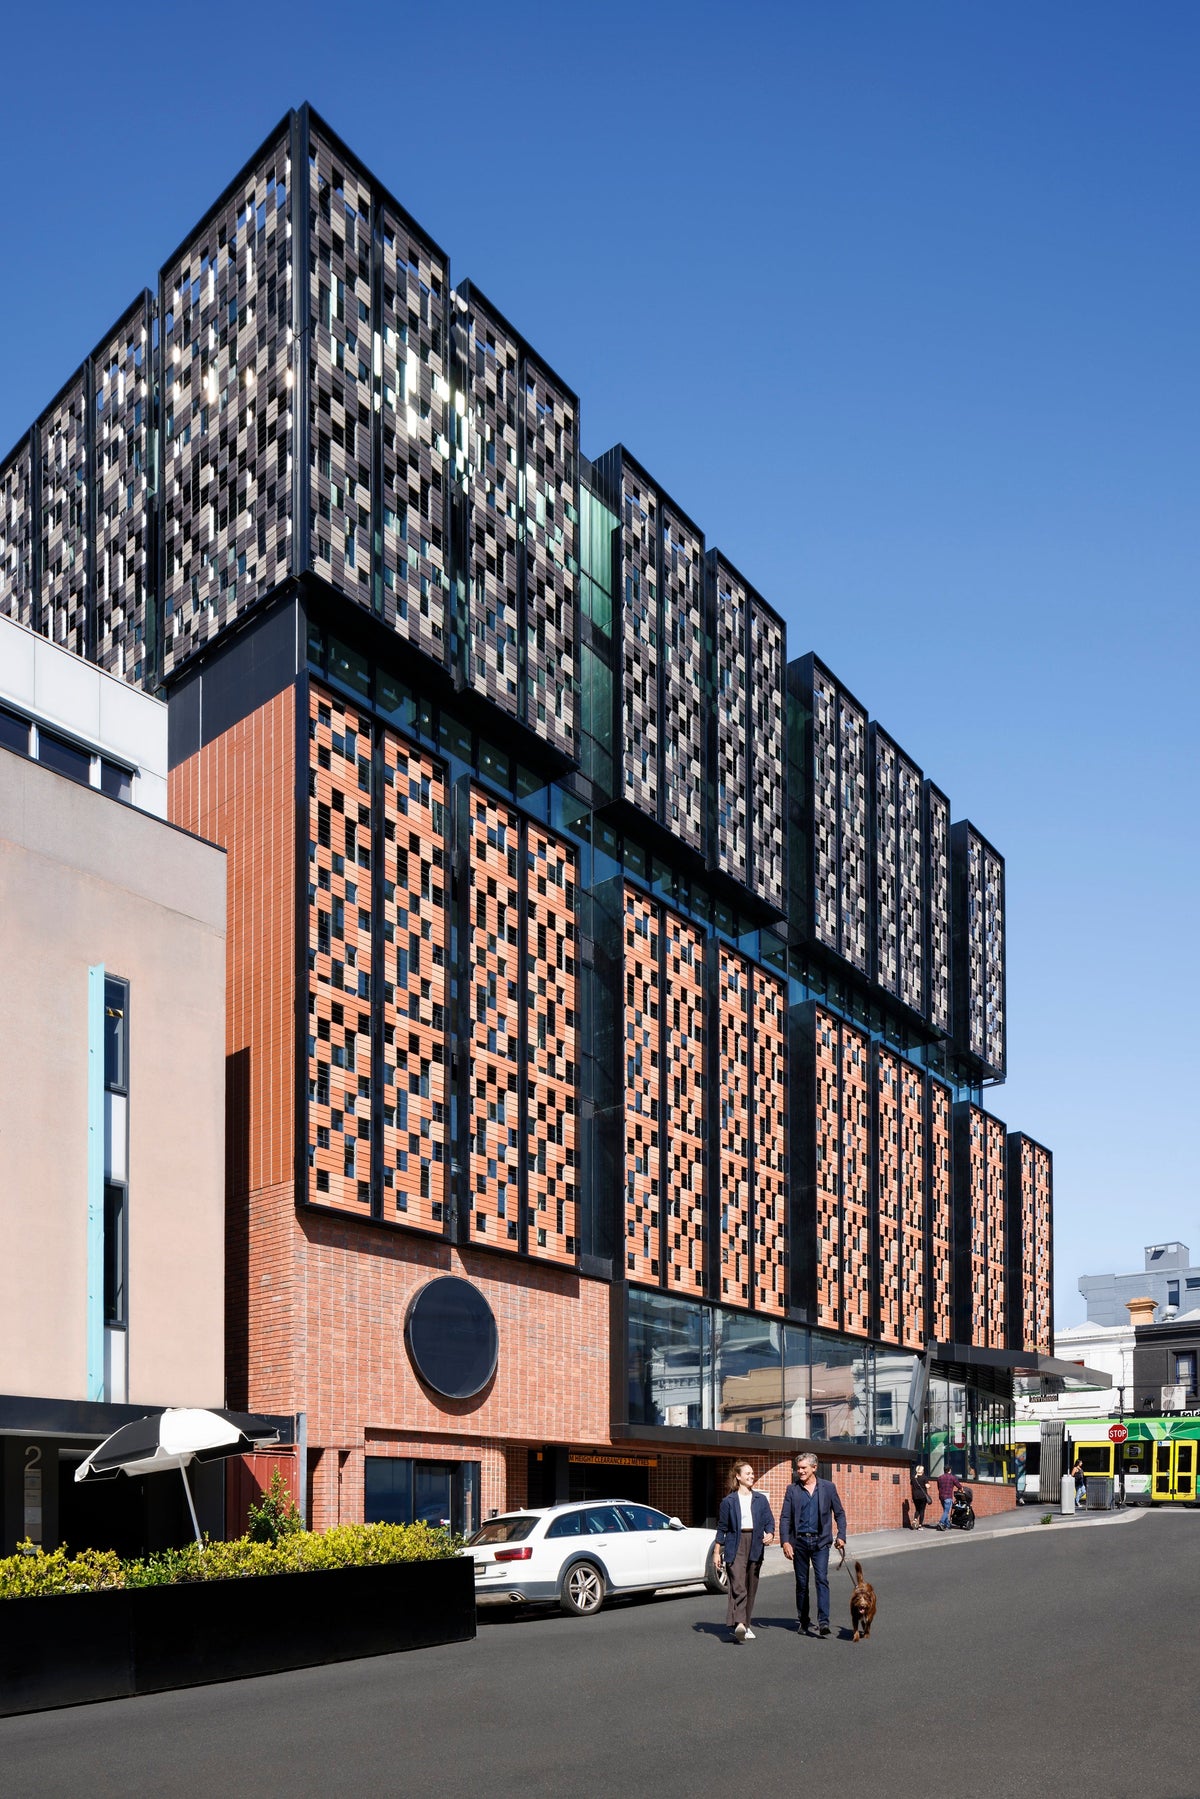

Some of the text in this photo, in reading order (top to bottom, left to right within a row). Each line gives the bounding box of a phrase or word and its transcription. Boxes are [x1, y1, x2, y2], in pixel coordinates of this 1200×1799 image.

[1109, 1429, 1127, 1438] STOP
[24, 1445, 42, 1472] 2
[575, 1455, 594, 1463] HEIGHT
[595, 1456, 623, 1464] CLEARANCE
[631, 1458, 649, 1466] METRES
